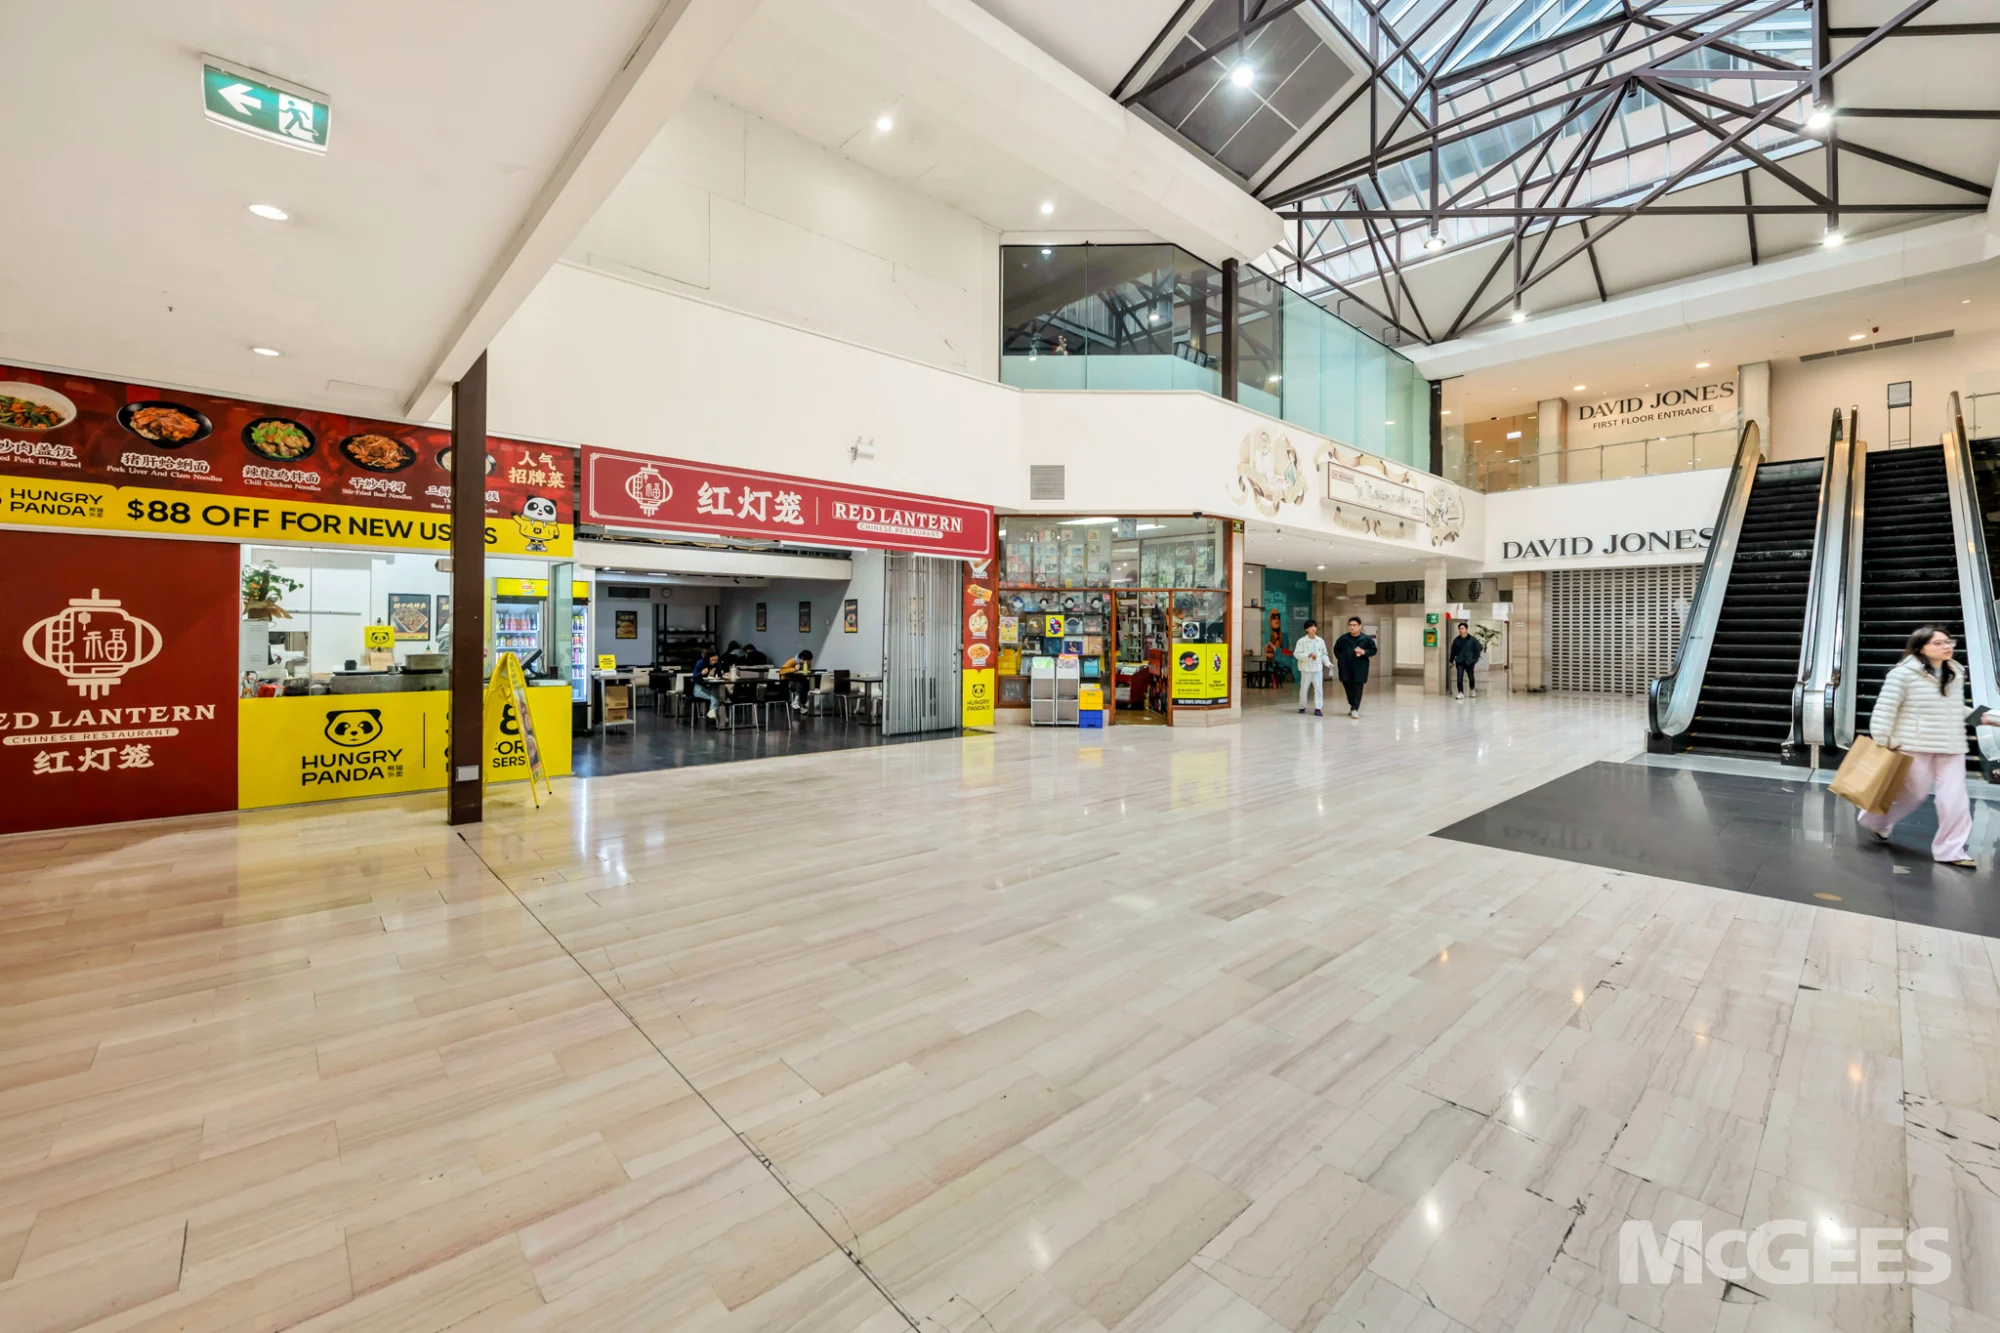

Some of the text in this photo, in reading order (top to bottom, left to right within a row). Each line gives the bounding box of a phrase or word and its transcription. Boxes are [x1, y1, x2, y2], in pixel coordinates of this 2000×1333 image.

[1579, 382, 1734, 421] DAVID JONES
[1593, 405, 1714, 429] FIRST FLOOR ENTRANCE
[14, 456, 35, 464] Pork
[39, 458, 58, 466] Rice
[121, 453, 210, 473] 猪肝蛤蜊面
[517, 450, 556, 471] 人气
[106, 465, 126, 473] Pork
[129, 467, 148, 475] Liver
[193, 474, 223, 482] Noodles
[508, 466, 566, 488] 招牌菜
[10, 488, 103, 505] HUNGRY
[696, 481, 805, 525] 红灯笼
[10, 501, 86, 517] PANDA
[834, 502, 962, 532] RED LANTERN
[127, 498, 498, 545] $88 OFF FOR NEW USS
[859, 523, 941, 537] CHINESE RESTAURANT
[1502, 527, 1715, 560] DAVID JONES
[0, 704, 216, 731] ED LANTERN
[12, 729, 171, 744] CHINESE RESTAURANT
[302, 748, 403, 769] HUNGRY
[494, 740, 525, 756] OR
[33, 743, 154, 775] 红灯笼
[492, 756, 526, 768] SERS
[302, 766, 385, 786] PANDA
